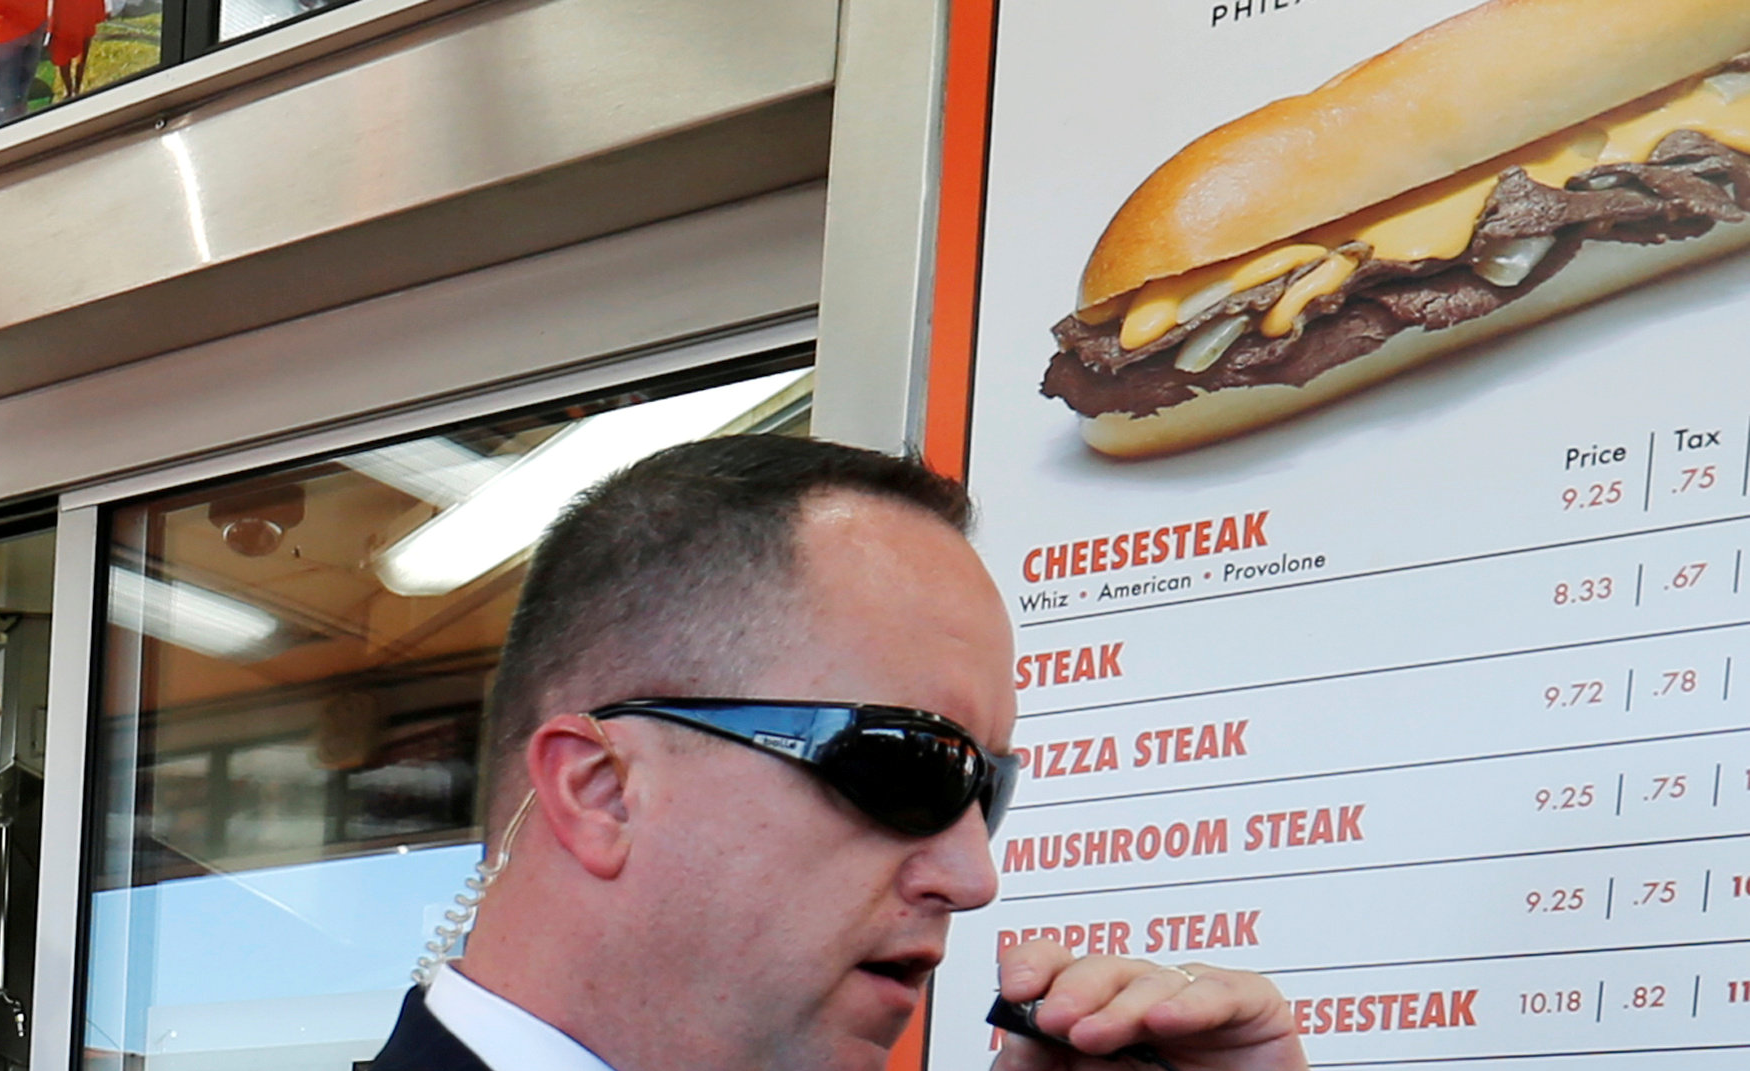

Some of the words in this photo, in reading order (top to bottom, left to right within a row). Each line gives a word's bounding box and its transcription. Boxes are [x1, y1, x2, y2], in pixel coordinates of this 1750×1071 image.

[1565, 444, 1626, 470] Price
[1674, 428, 1721, 451] Tax
[1562, 481, 1622, 510] 9.25
[1672, 466, 1716, 493] .75
[1023, 509, 1270, 583] CHEESESTEAK
[1019, 590, 1069, 612] Whiz
[1098, 574, 1192, 601] American
[1224, 553, 1326, 582] Provolone
[1553, 577, 1612, 605] 8.33
[1664, 563, 1708, 590] .67
[1015, 642, 1124, 690] STEAK
[1544, 681, 1603, 708] 9.72
[1653, 670, 1696, 696] .78
[1011, 736, 1119, 779] PIZZA
[1133, 720, 1249, 768] STEAK
[1535, 785, 1594, 811] 9.25
[1643, 775, 1687, 801] .75
[1003, 819, 1228, 874] MUSHROOM
[1244, 804, 1366, 851] STEAK
[1526, 888, 1584, 913] 9.25
[1633, 881, 1676, 905] .75
[1145, 910, 1260, 953] STEAK
[1520, 990, 1581, 1014] 10.18
[1623, 985, 1666, 1009] .82
